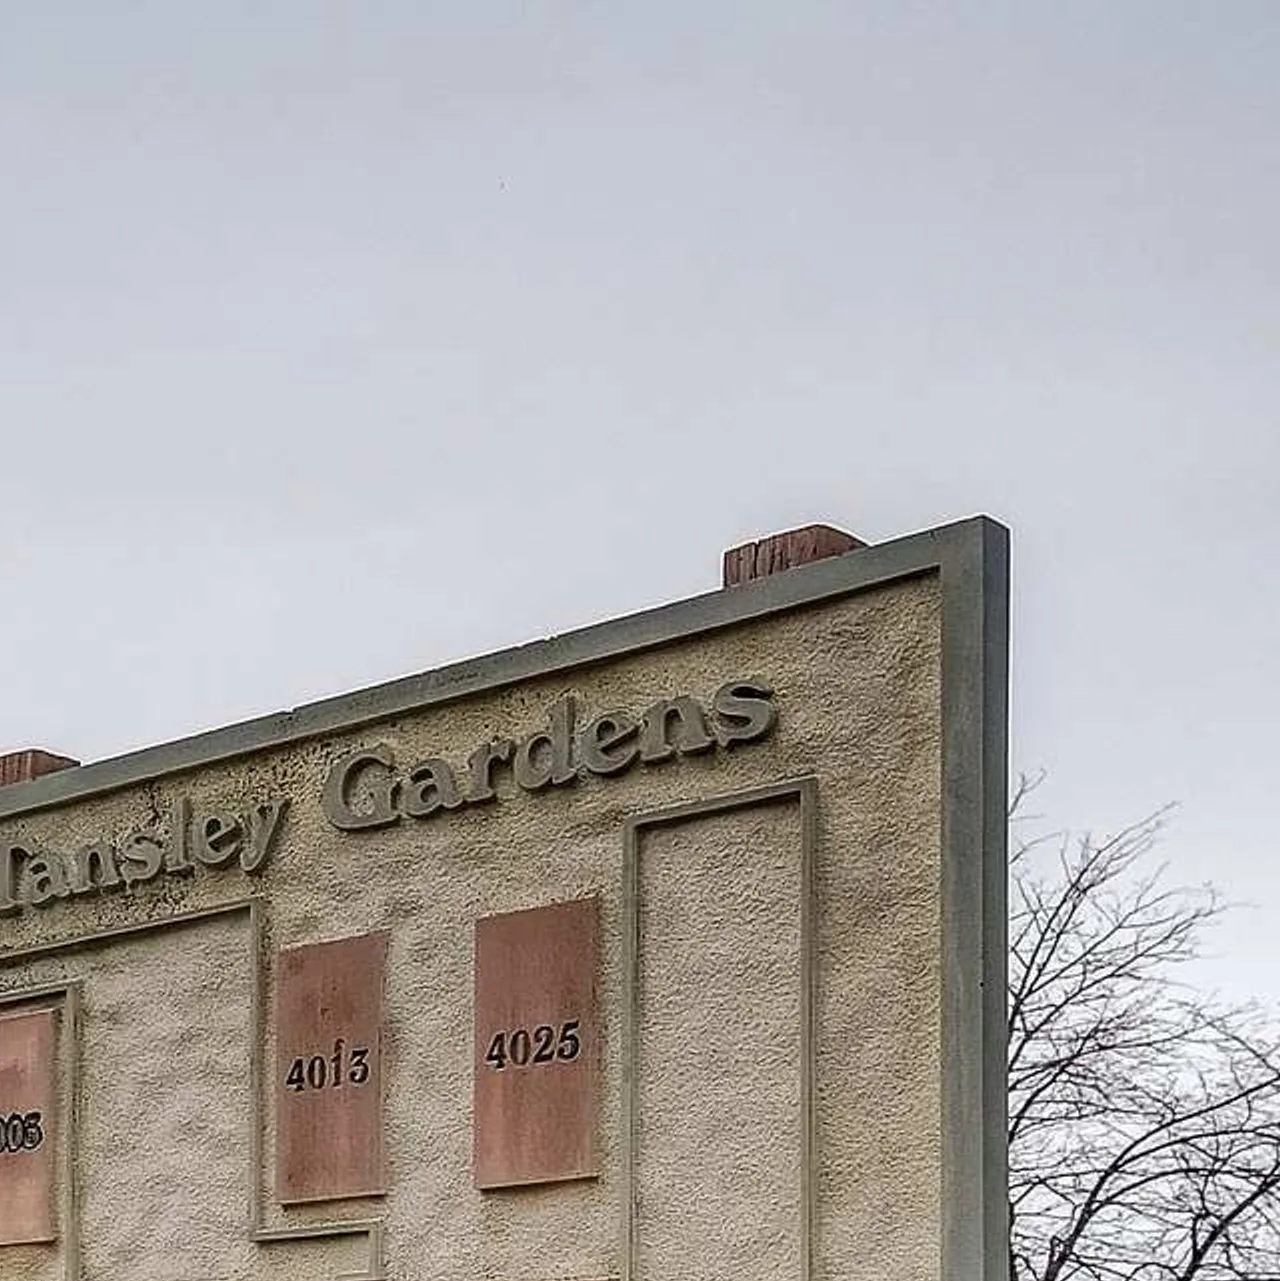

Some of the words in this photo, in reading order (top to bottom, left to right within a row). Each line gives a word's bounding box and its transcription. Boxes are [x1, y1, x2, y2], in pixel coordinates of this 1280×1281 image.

[321, 678, 778, 831] Gardens
[285, 1045, 369, 1092] 4013
[485, 1019, 579, 1069] 4025
